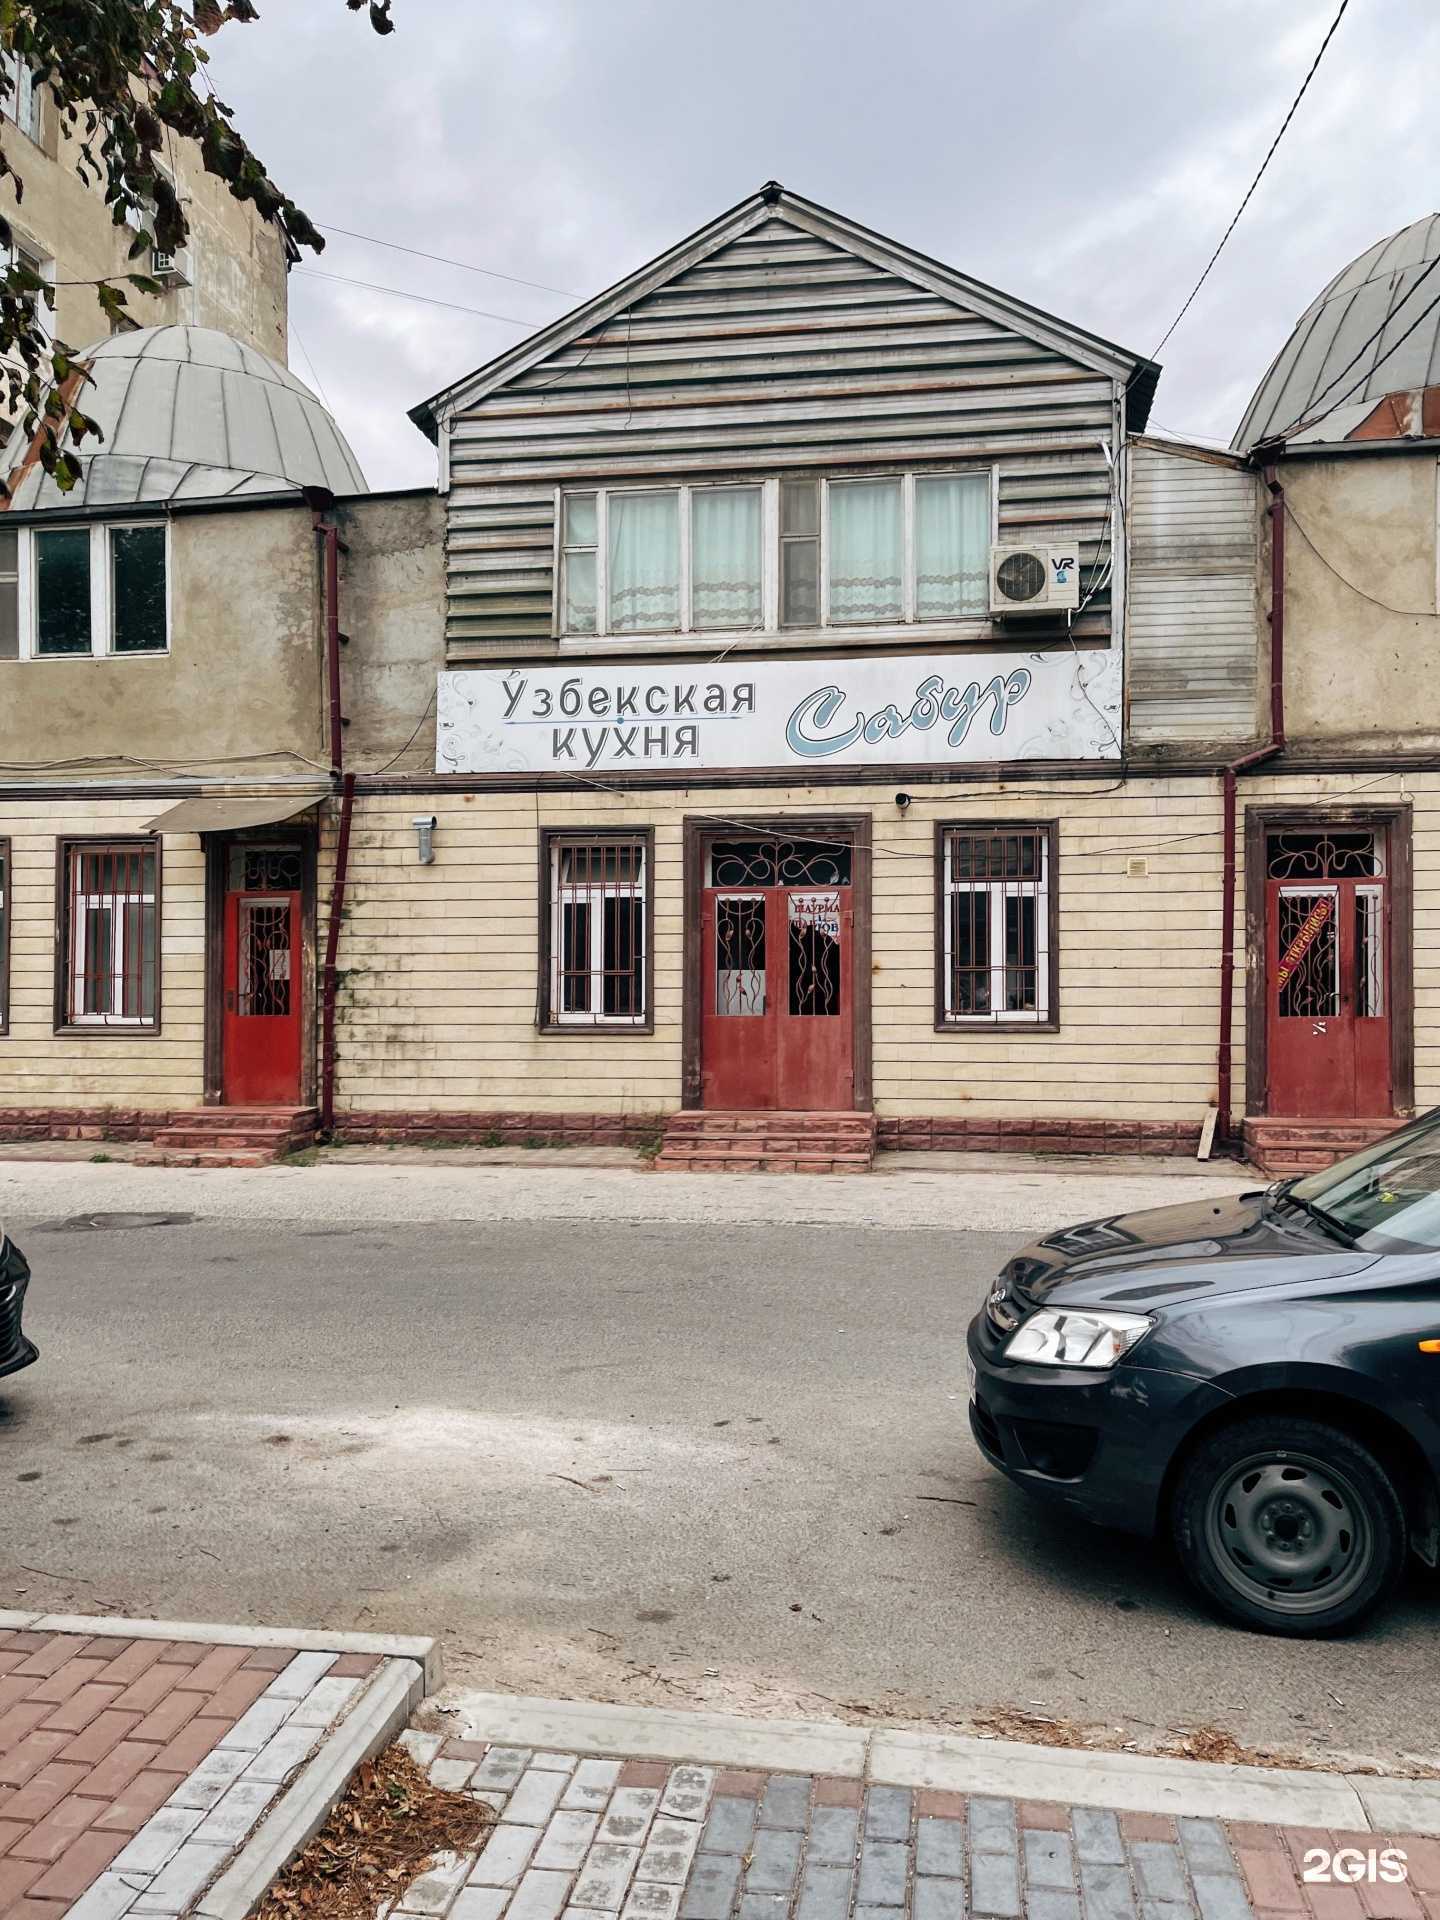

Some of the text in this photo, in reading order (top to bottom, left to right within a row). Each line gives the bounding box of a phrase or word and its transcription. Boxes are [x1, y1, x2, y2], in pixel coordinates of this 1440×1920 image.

[501, 677, 756, 719] Узбекская
[785, 667, 1032, 758] Сабур
[551, 724, 700, 769] кухня
